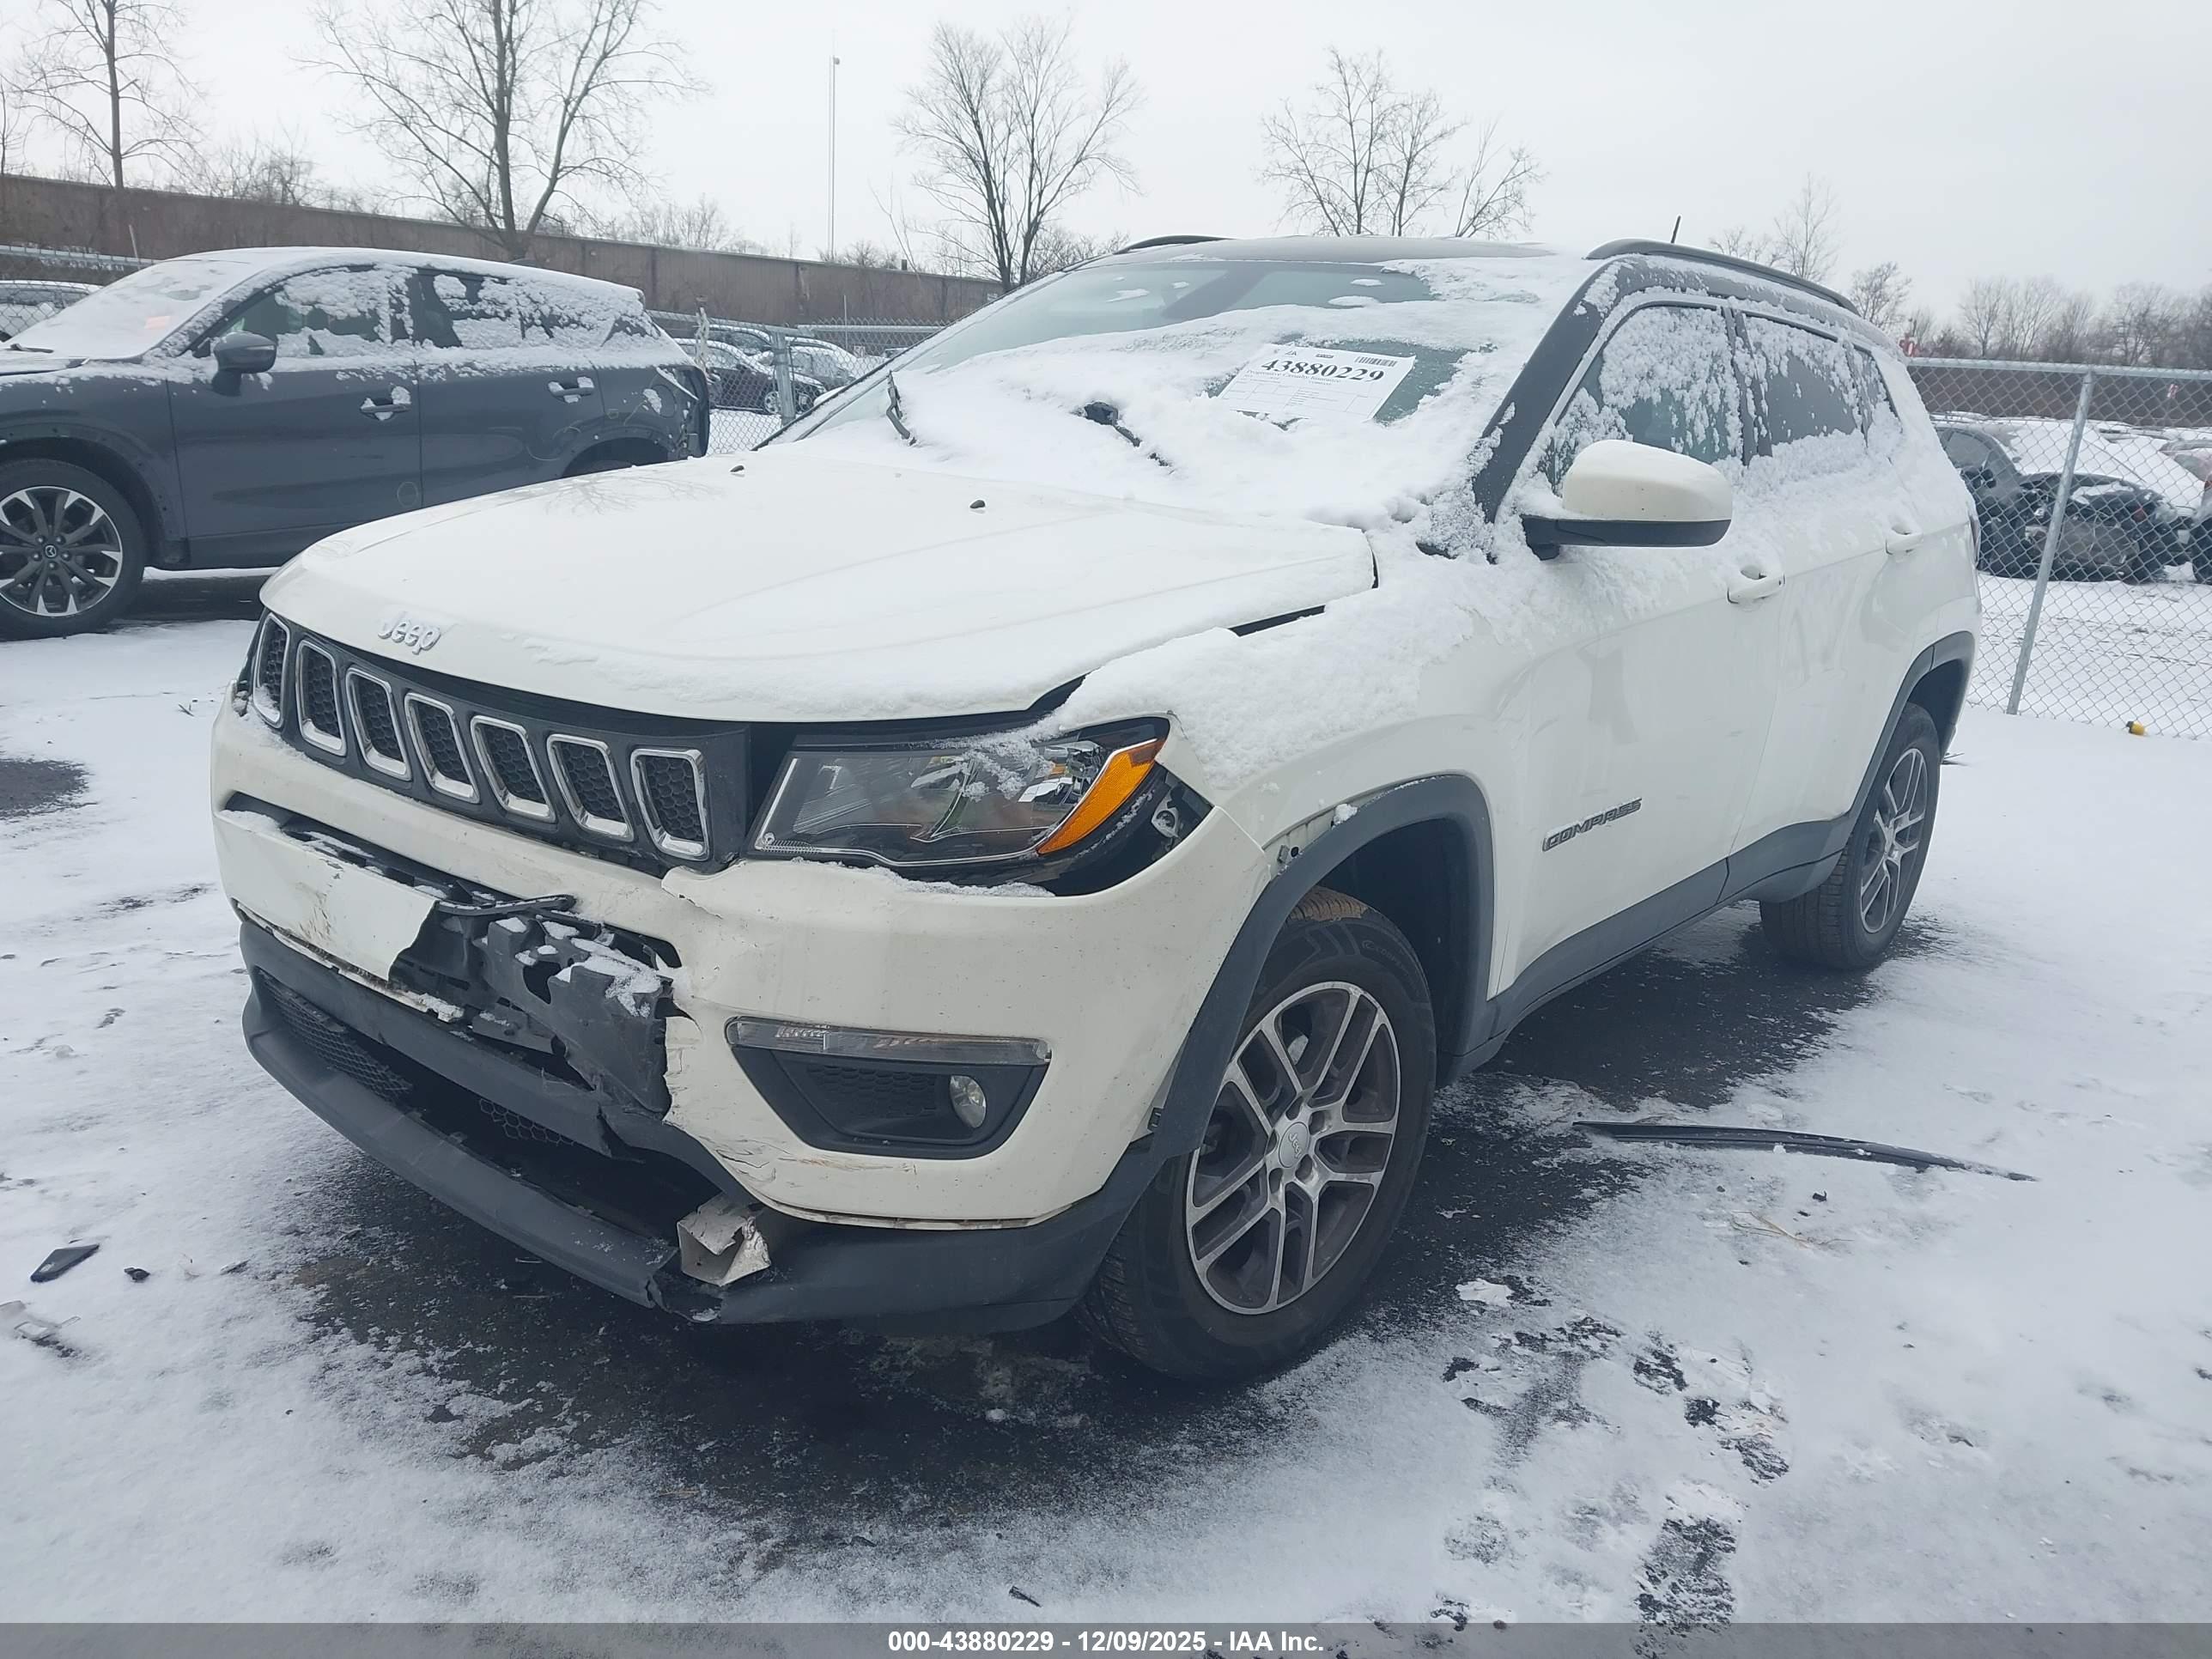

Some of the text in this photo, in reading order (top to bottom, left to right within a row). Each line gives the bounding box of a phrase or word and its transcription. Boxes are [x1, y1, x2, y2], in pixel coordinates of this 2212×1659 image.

[1261, 359, 1384, 382] 43880229
[378, 612, 441, 655] Jeep
[1542, 798, 1642, 852] COMPASS
